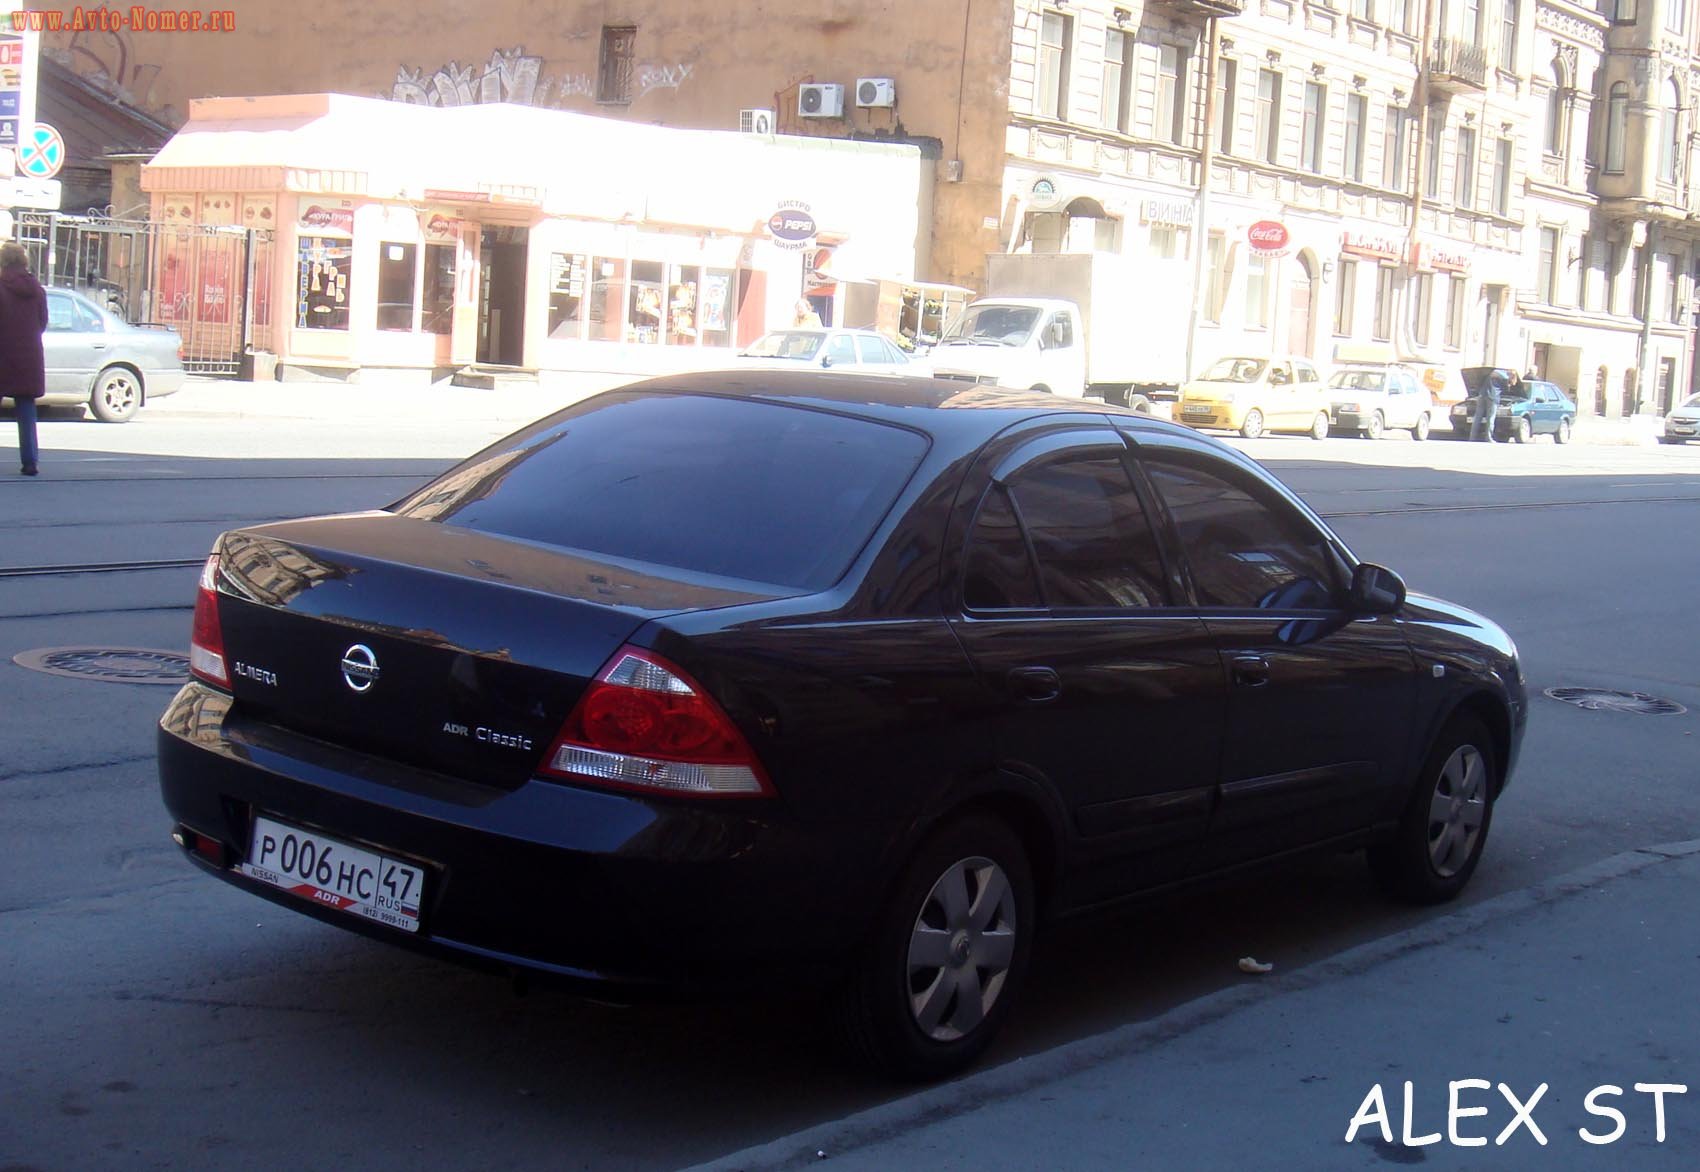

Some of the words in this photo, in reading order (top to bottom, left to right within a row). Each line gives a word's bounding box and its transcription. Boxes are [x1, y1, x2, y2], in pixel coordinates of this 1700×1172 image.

[784, 219, 813, 231] PEPSI
[774, 238, 808, 250] ШАУРМА
[234, 661, 278, 687] ALMERA
[443, 722, 469, 736] ADR
[475, 727, 533, 751] Classic
[251, 868, 279, 884] NISSAN
[383, 864, 414, 901] 47
[313, 889, 341, 906] ADR
[377, 895, 401, 912] RUS
